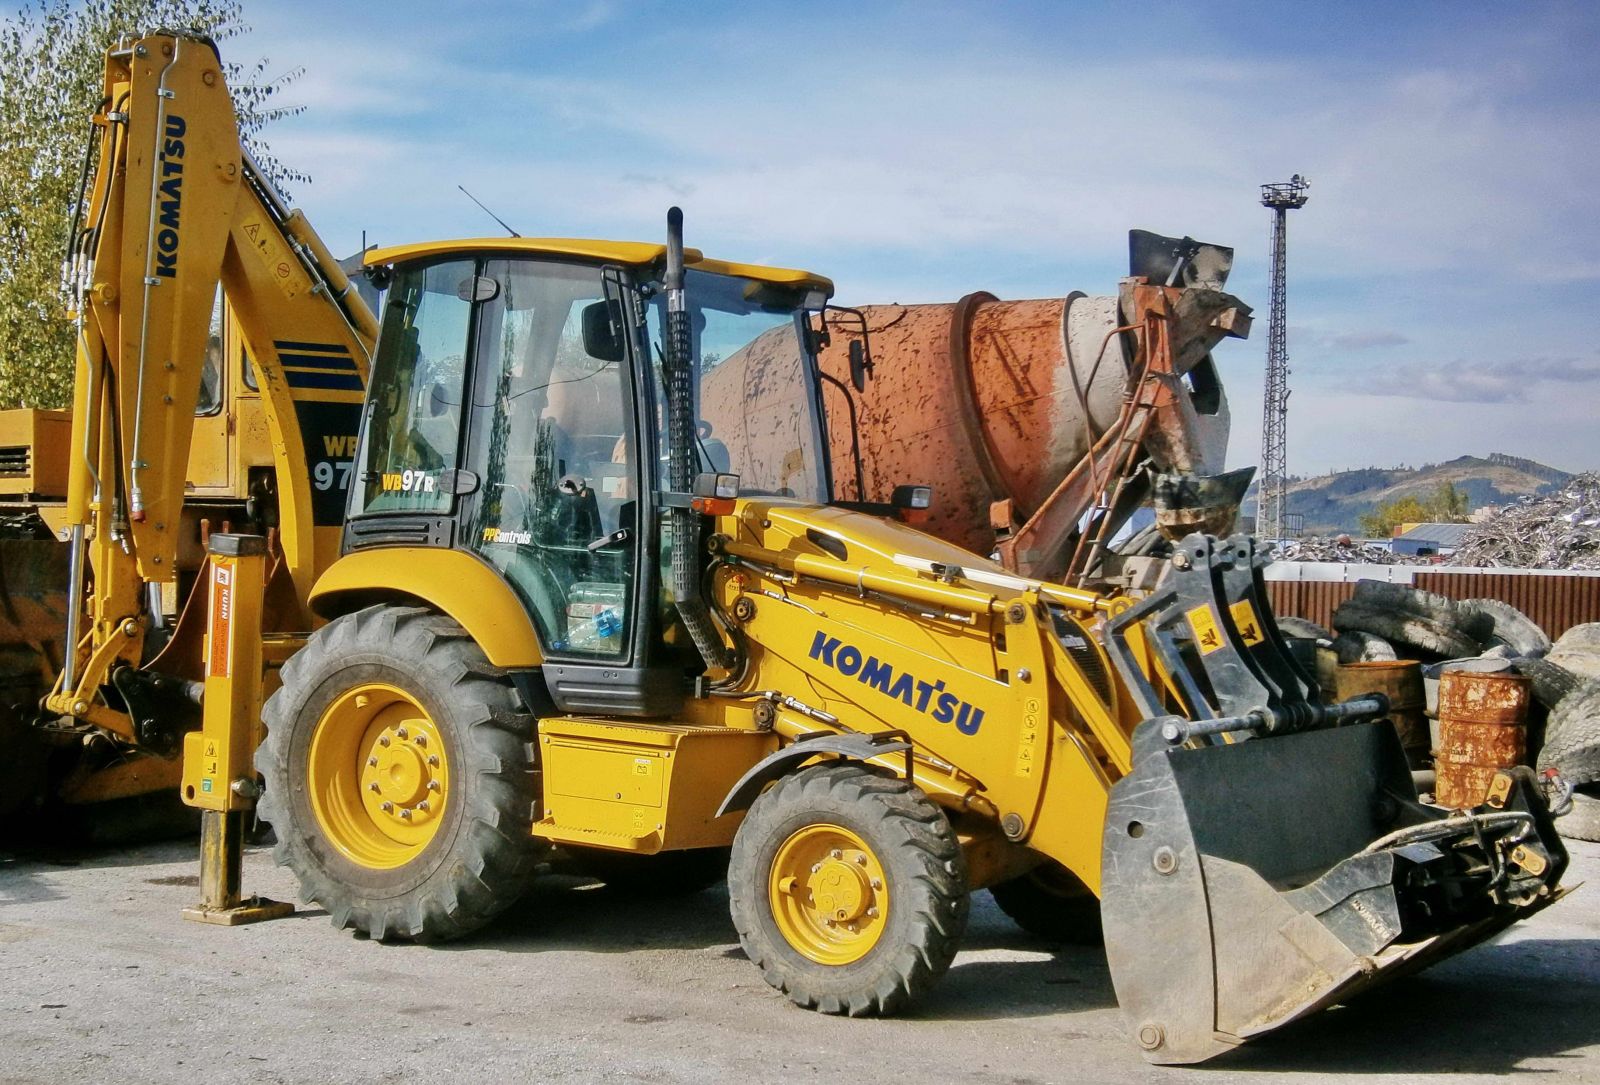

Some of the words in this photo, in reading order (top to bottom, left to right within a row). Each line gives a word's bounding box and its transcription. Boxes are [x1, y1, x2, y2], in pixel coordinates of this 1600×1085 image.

[156, 115, 186, 278] KOMATSU
[382, 470, 434, 492] WB97R
[483, 527, 531, 544] PPControls
[808, 630, 985, 737] KOMATSU
